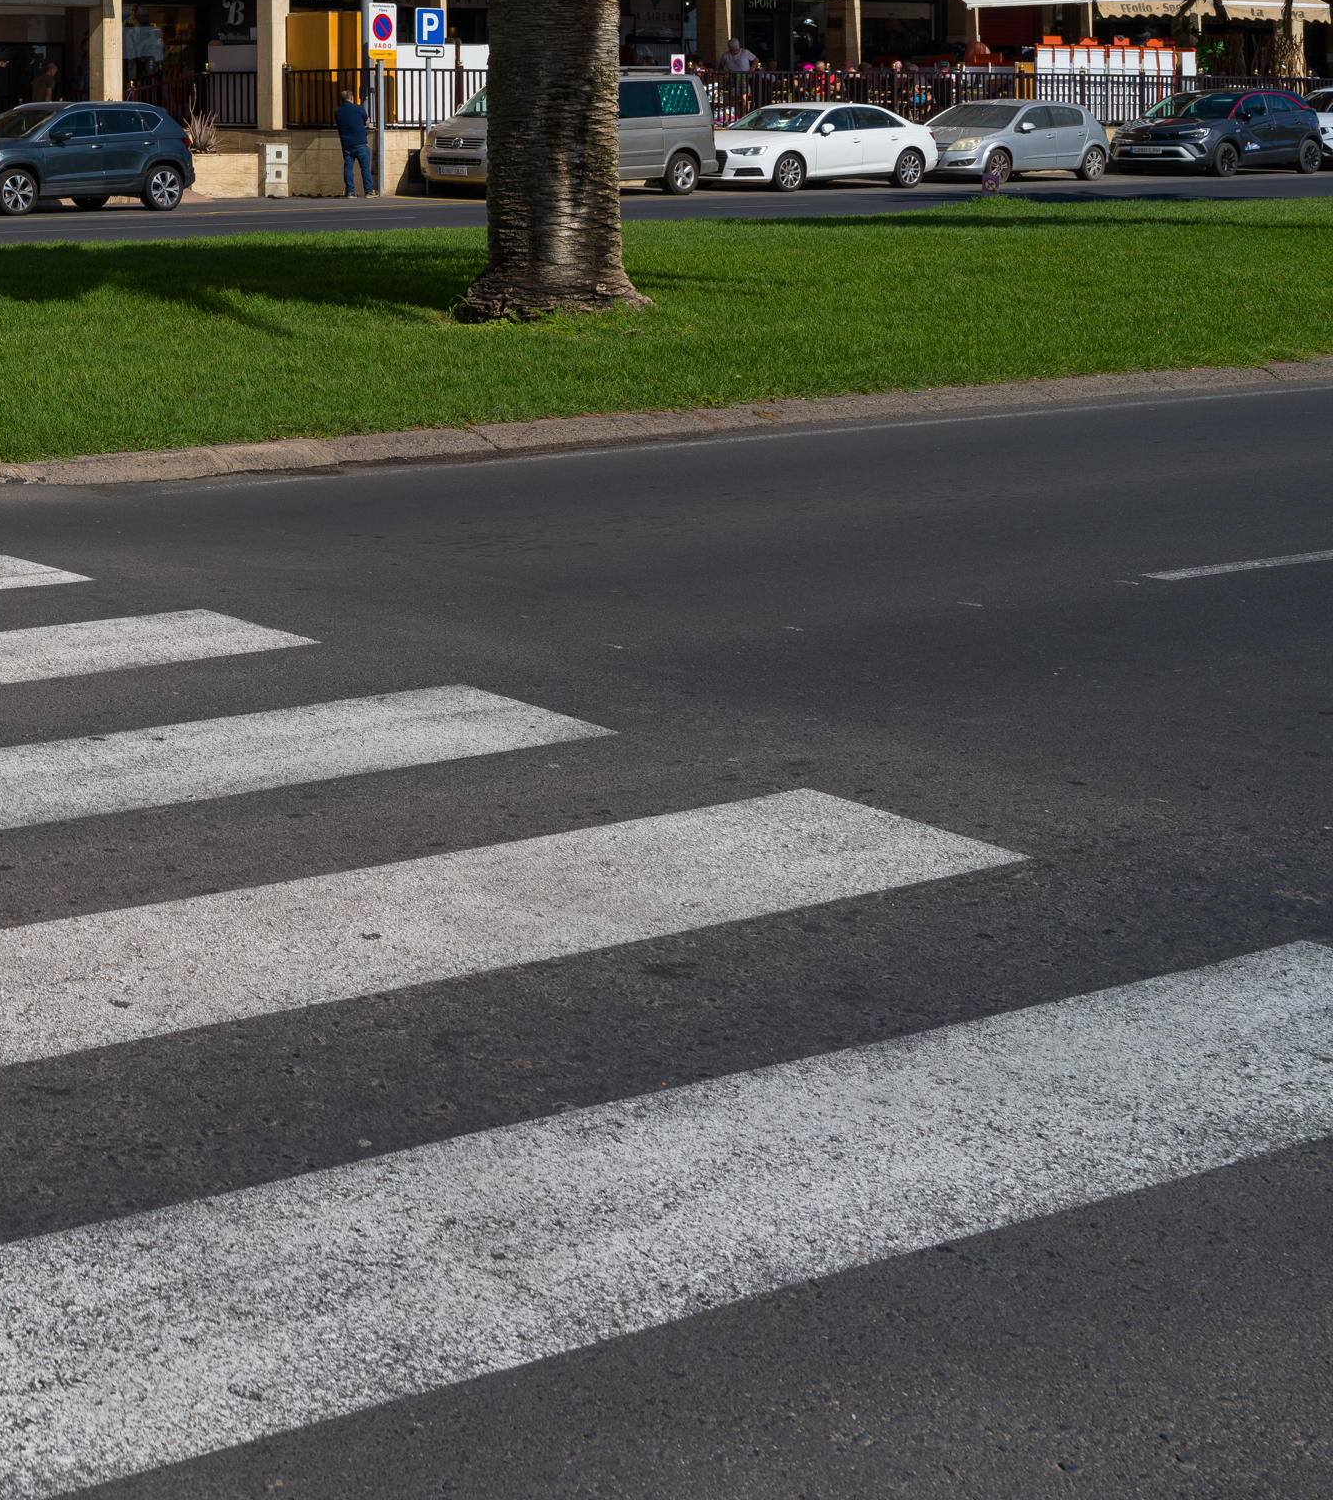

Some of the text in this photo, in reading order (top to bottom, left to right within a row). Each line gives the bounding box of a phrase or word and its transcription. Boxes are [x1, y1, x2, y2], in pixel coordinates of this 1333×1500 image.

[1121, 3, 1153, 13] FFolio
[1250, 7, 1264, 17] La
[422, 12, 439, 41] P
